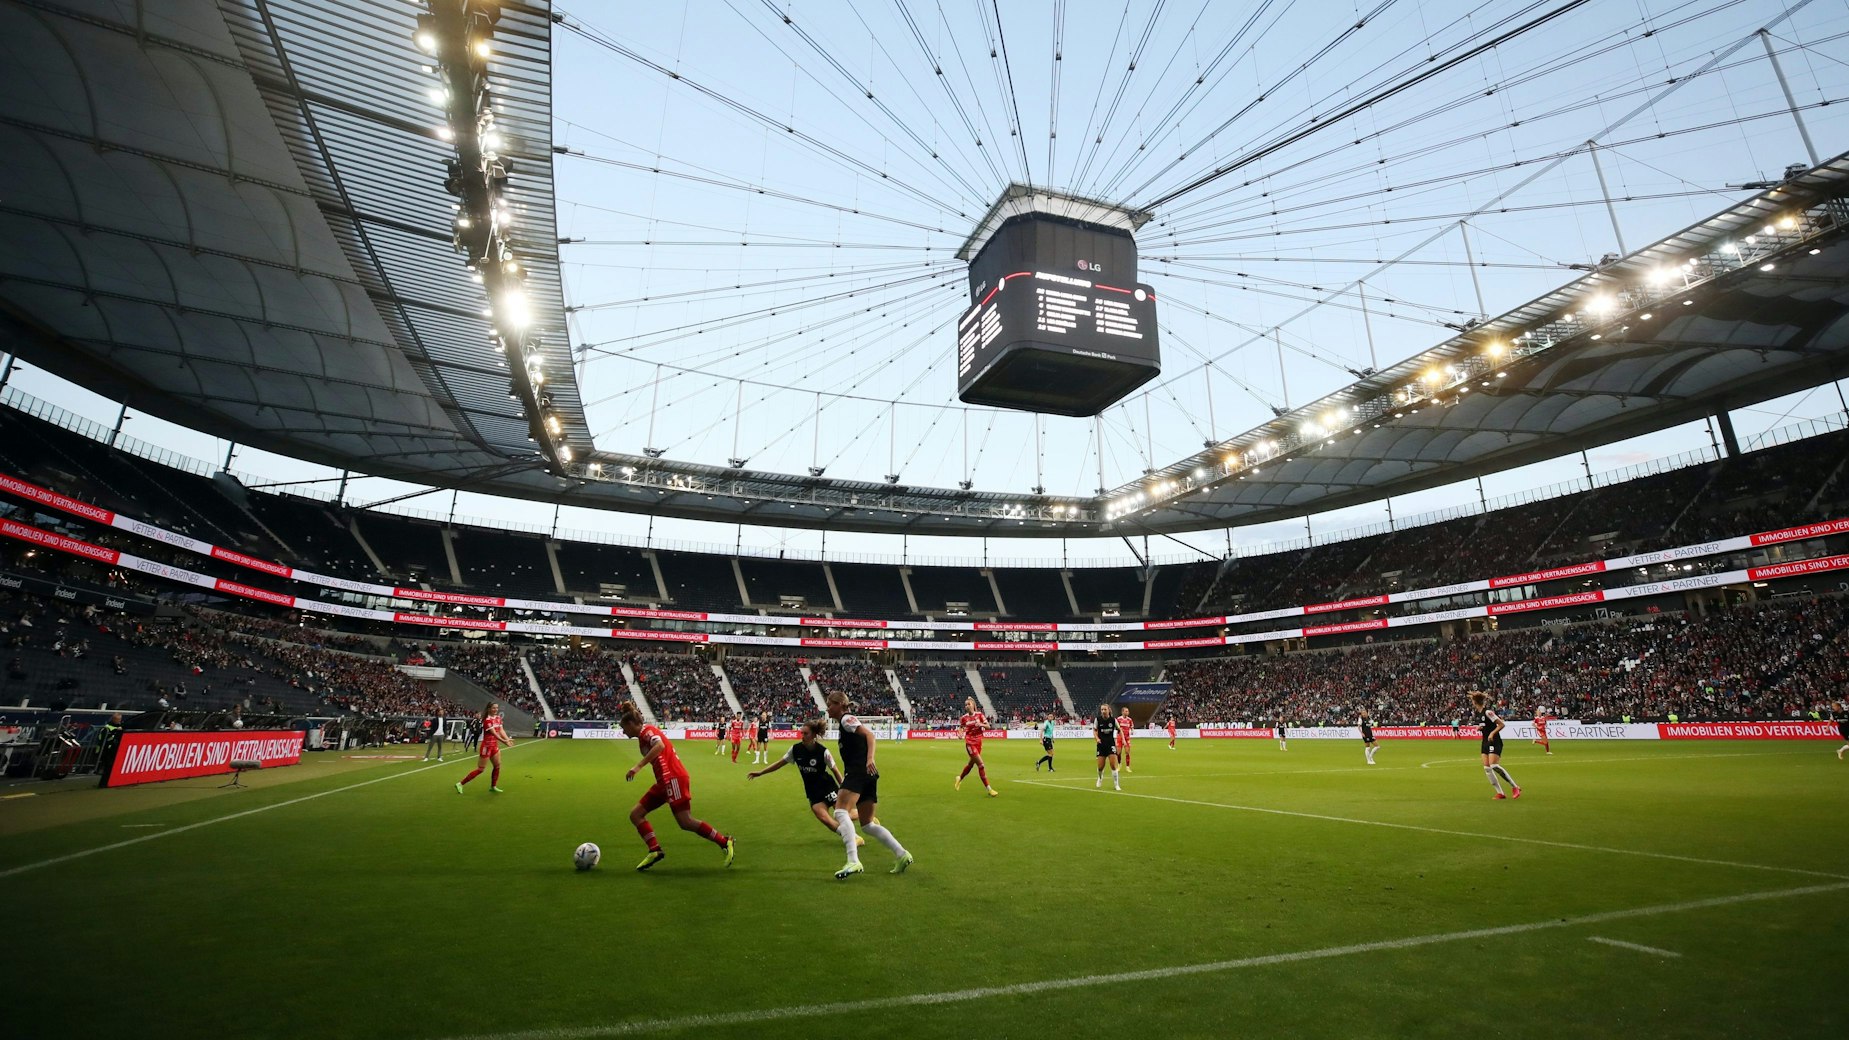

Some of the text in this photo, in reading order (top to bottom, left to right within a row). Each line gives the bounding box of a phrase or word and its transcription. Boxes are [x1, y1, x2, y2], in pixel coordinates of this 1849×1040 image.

[1089, 264, 1101, 272] LG
[38, 491, 53, 501] SIND
[53, 498, 107, 520] VERTRAUENSSACHE
[132, 522, 156, 537] VETTER
[166, 532, 194, 548] PARTNER
[1759, 529, 1808, 542] IMMOBILIEN
[1810, 525, 1831, 534] SIND
[2, 523, 115, 561] IMMOBILIEN SIND VERTRAUENSSACHE
[1628, 555, 1661, 565] VETTER
[1675, 544, 1719, 556] PARTNER
[136, 560, 160, 574] VETTER
[170, 570, 199, 583] PARTNER
[1494, 564, 1596, 585] IMMOBILIEN SIND VERTRAUENSSACHE
[1756, 564, 1807, 577] IMMOBILIEN
[1808, 560, 1829, 568] SIND
[307, 574, 330, 584] VETTER
[339, 581, 372, 592] PARTNER
[1625, 585, 1659, 595] VETTER
[1673, 577, 1718, 588] PARTNER
[55, 586, 76, 599] indeed
[399, 590, 432, 599] IMMOBILIEN
[447, 595, 498, 604] VERTRAUENSSACHE
[1405, 591, 1428, 599] VETTER
[1437, 585, 1469, 595] PARTNER
[105, 598, 125, 609] indeed
[308, 602, 331, 612] VETTER
[340, 608, 373, 617] PARTNER
[559, 604, 591, 612] PARTNER
[1492, 594, 1596, 612] IMMOBILIEN SIND VERTRAUENSSACHE
[399, 615, 432, 623] IMMOBILIEN
[447, 619, 500, 628] VERTRAUENSSACHE
[1403, 615, 1426, 624] VETTER
[1436, 610, 1468, 620] PARTNER
[584, 730, 614, 738] VETTER
[1319, 730, 1350, 738] PARTNER
[1408, 729, 1422, 737] SIND
[1555, 727, 1567, 737] &
[1569, 727, 1625, 737] PARTNER
[1667, 726, 1732, 736] IMMOBILIEN
[1735, 726, 1762, 736] SIND
[120, 738, 303, 774] IMMOBILIEN SIND VERTRAUENSSACHE
